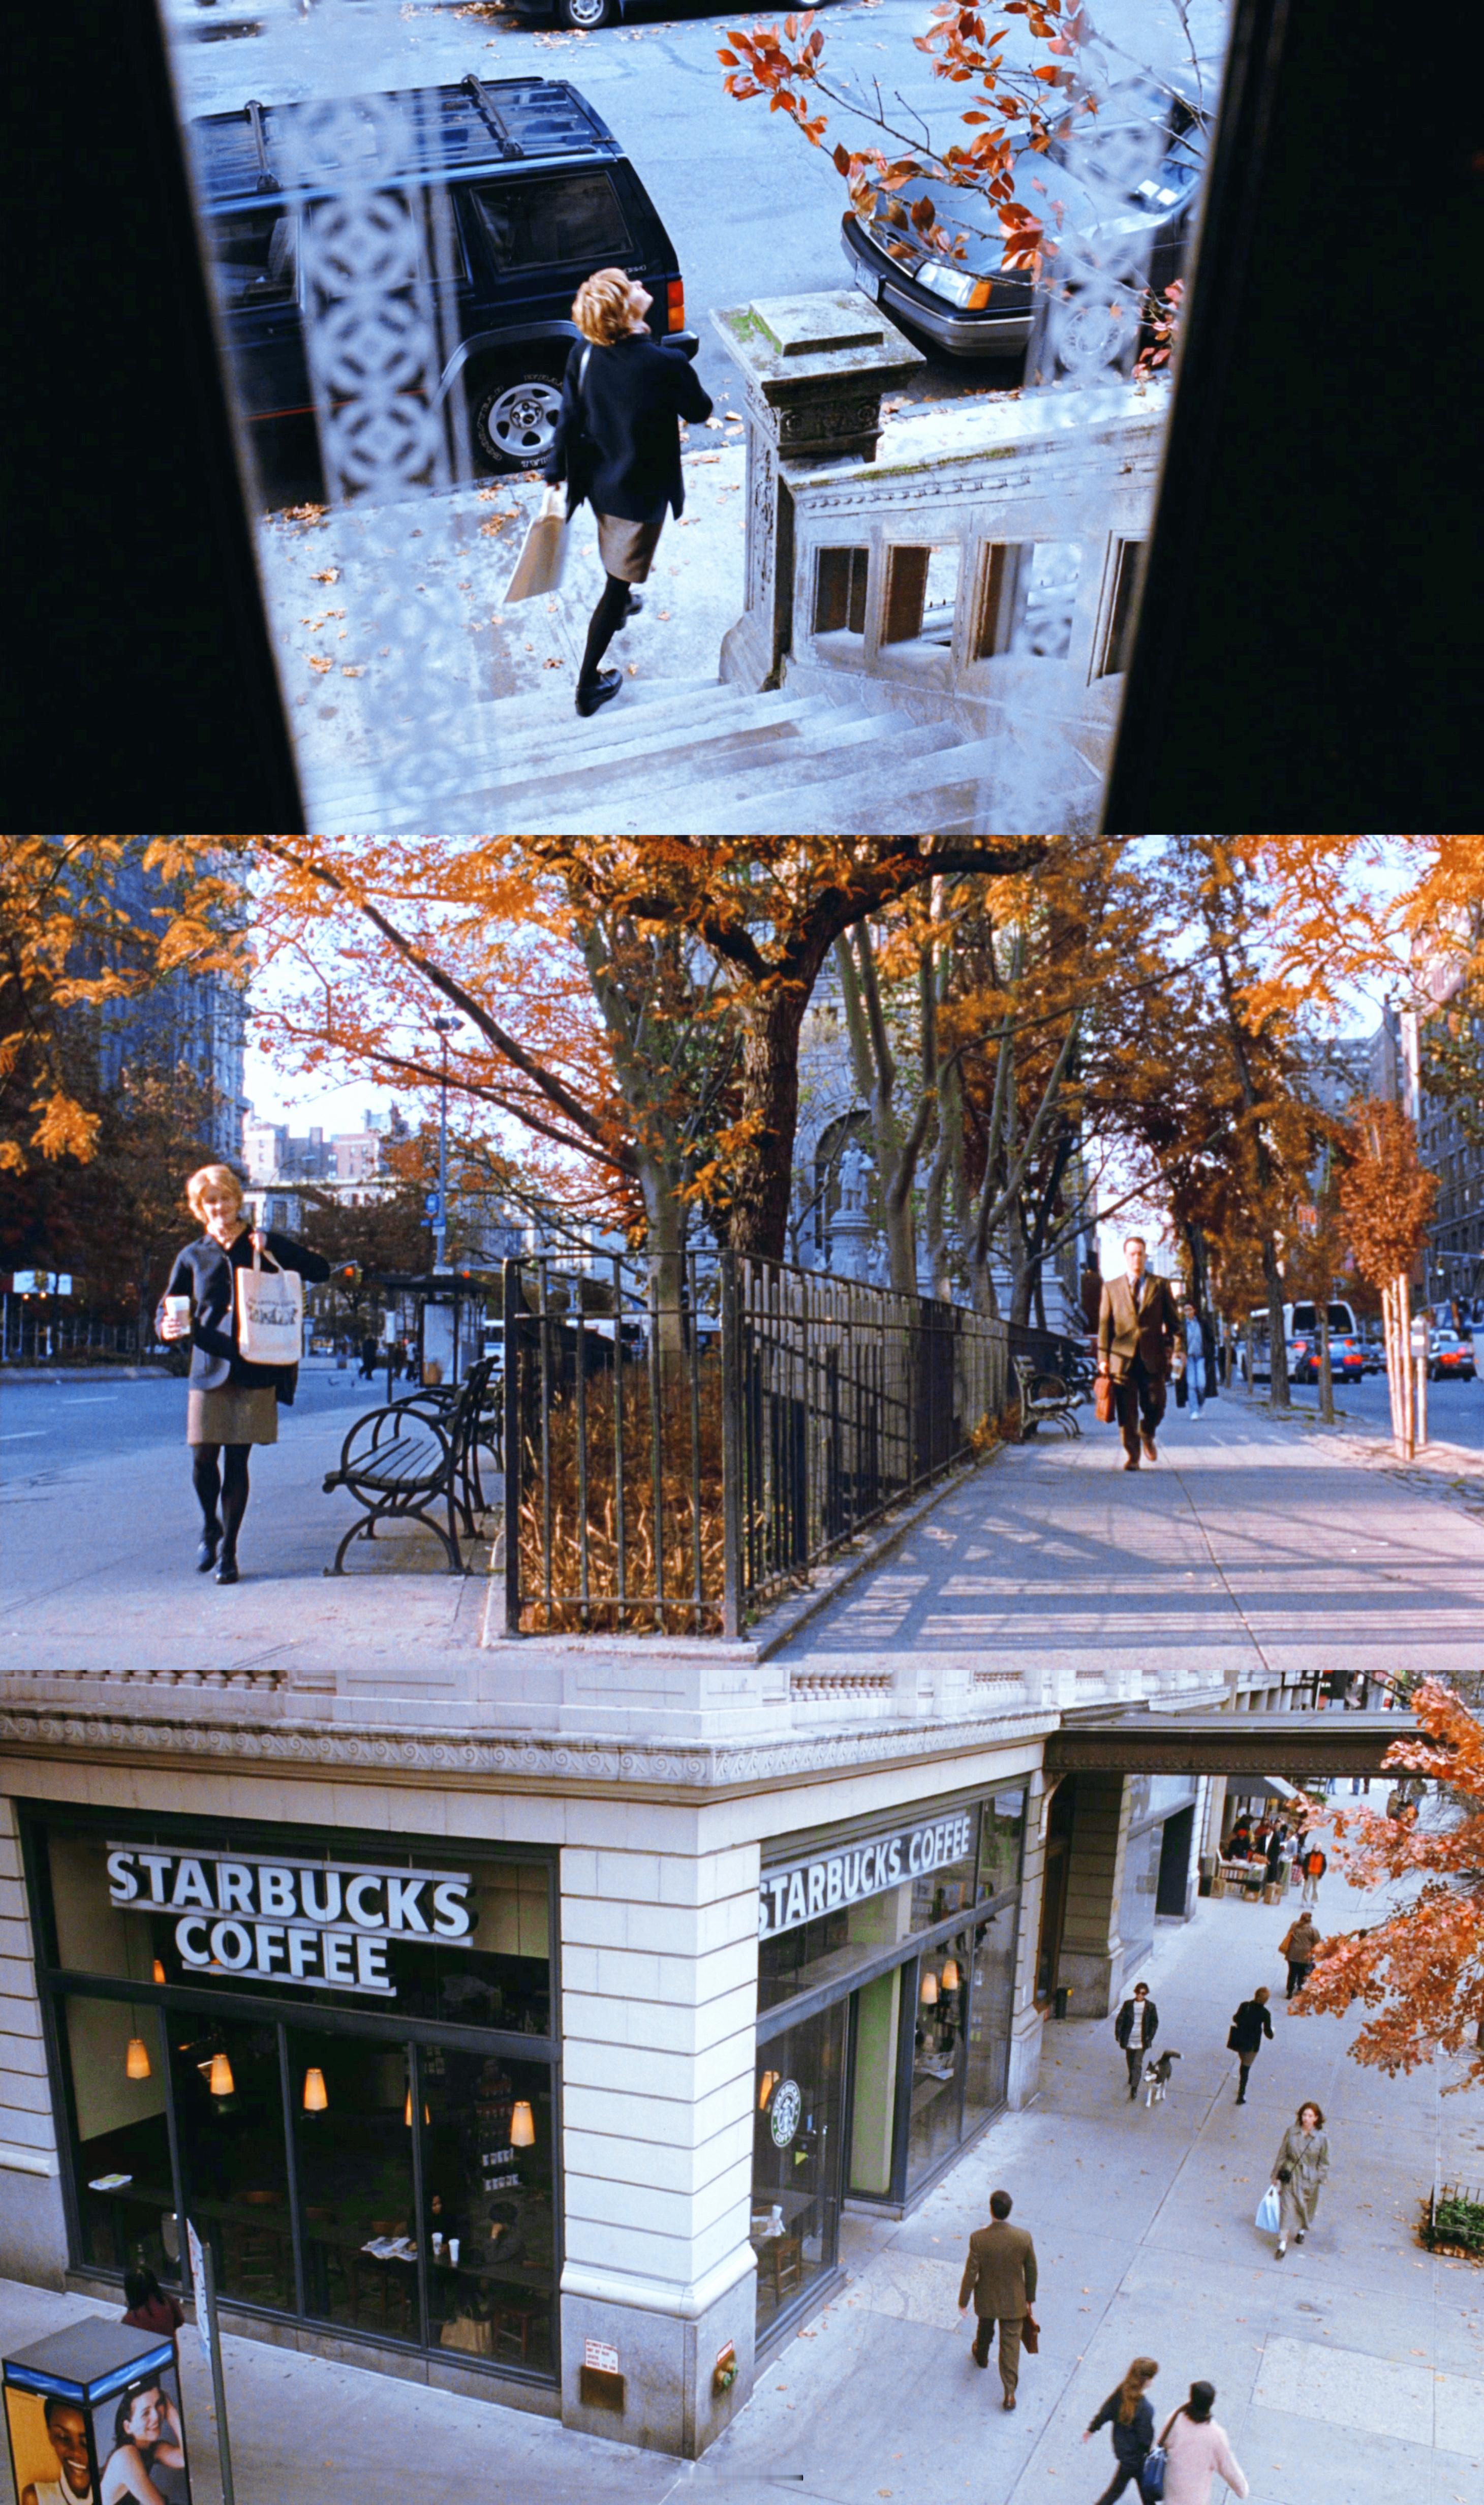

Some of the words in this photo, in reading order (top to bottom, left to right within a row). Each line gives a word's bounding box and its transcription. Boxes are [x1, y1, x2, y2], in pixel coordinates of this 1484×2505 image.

[106, 1851, 472, 1937] STARBUCKS
[759, 1838, 902, 1936] STARBUCKS
[909, 1816, 971, 1873] COFFEE
[174, 1916, 391, 1989] COFFEE
